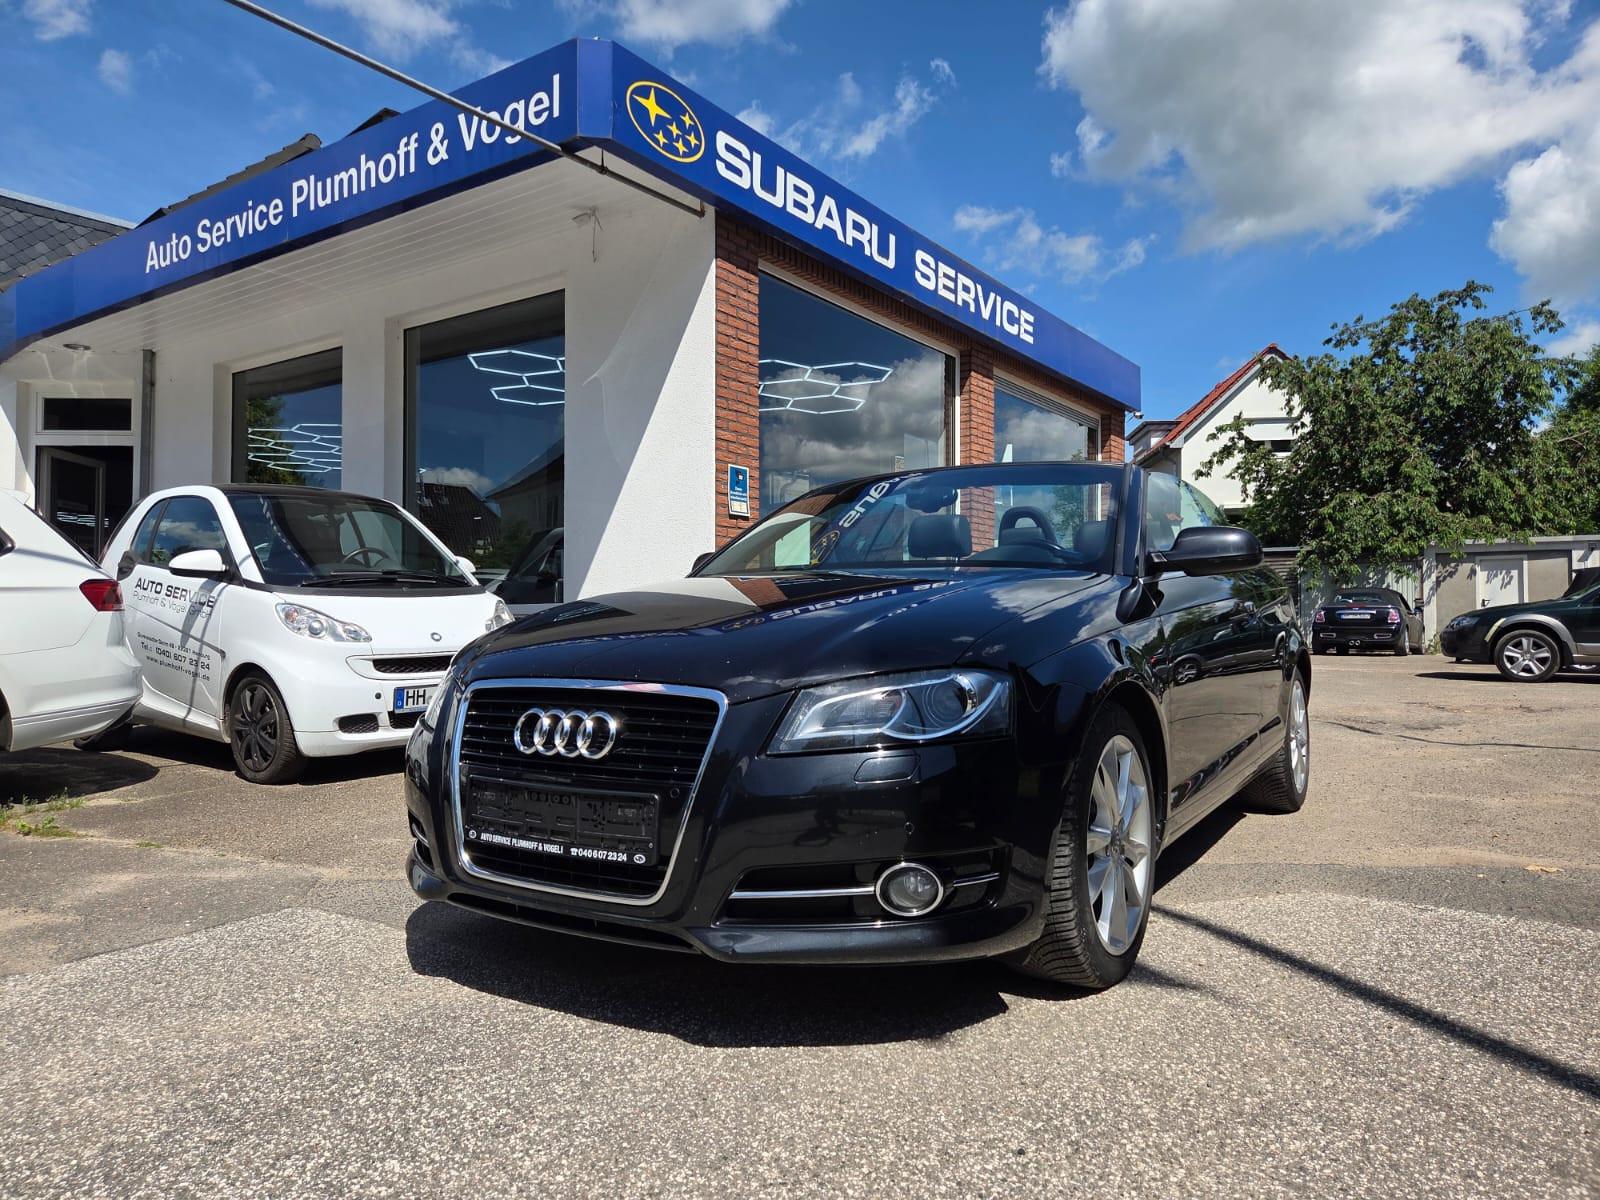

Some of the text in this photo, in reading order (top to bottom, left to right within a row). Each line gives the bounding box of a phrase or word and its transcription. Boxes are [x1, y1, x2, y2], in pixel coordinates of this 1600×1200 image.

[145, 74, 560, 274] Auto Service Plumhoff & Vogel
[715, 130, 1035, 344] SUBARU SERVICE
[135, 577, 216, 609] AUTO SERVICE
[173, 653, 187, 664] 607
[189, 658, 199, 667] 23
[200, 661, 210, 670] 24
[406, 689, 426, 706] HH
